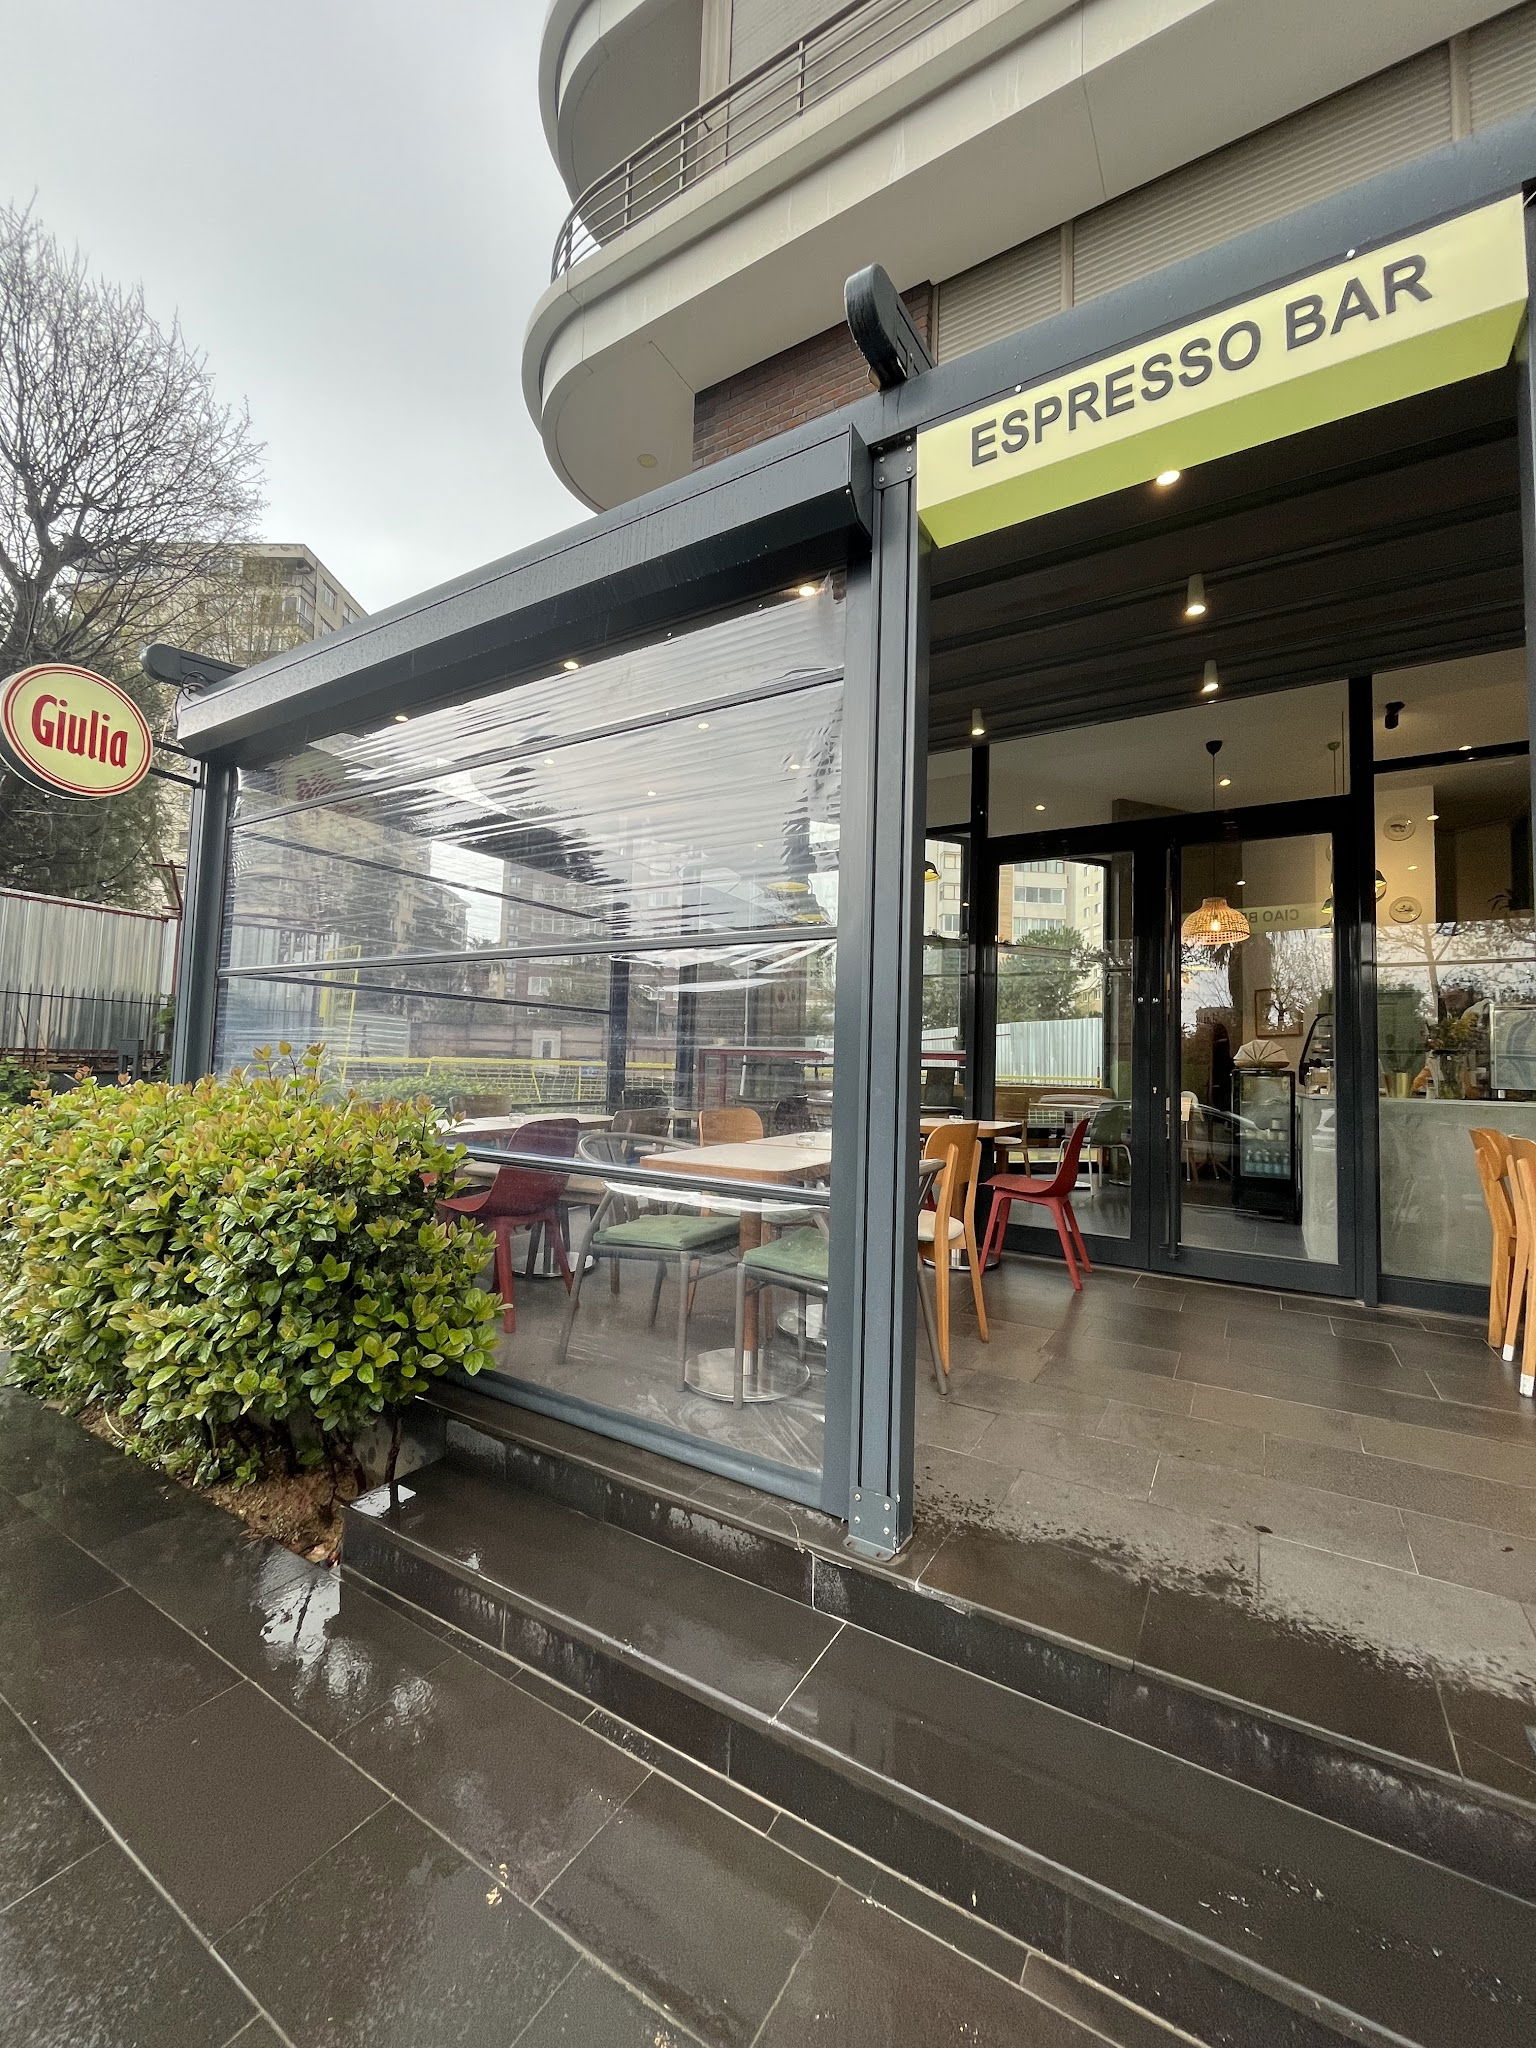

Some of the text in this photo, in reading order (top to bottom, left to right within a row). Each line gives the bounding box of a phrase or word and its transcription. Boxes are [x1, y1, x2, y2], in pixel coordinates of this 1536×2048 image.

[970, 253, 1434, 467] ESPRESSO BAR
[31, 694, 129, 768] Giulia
